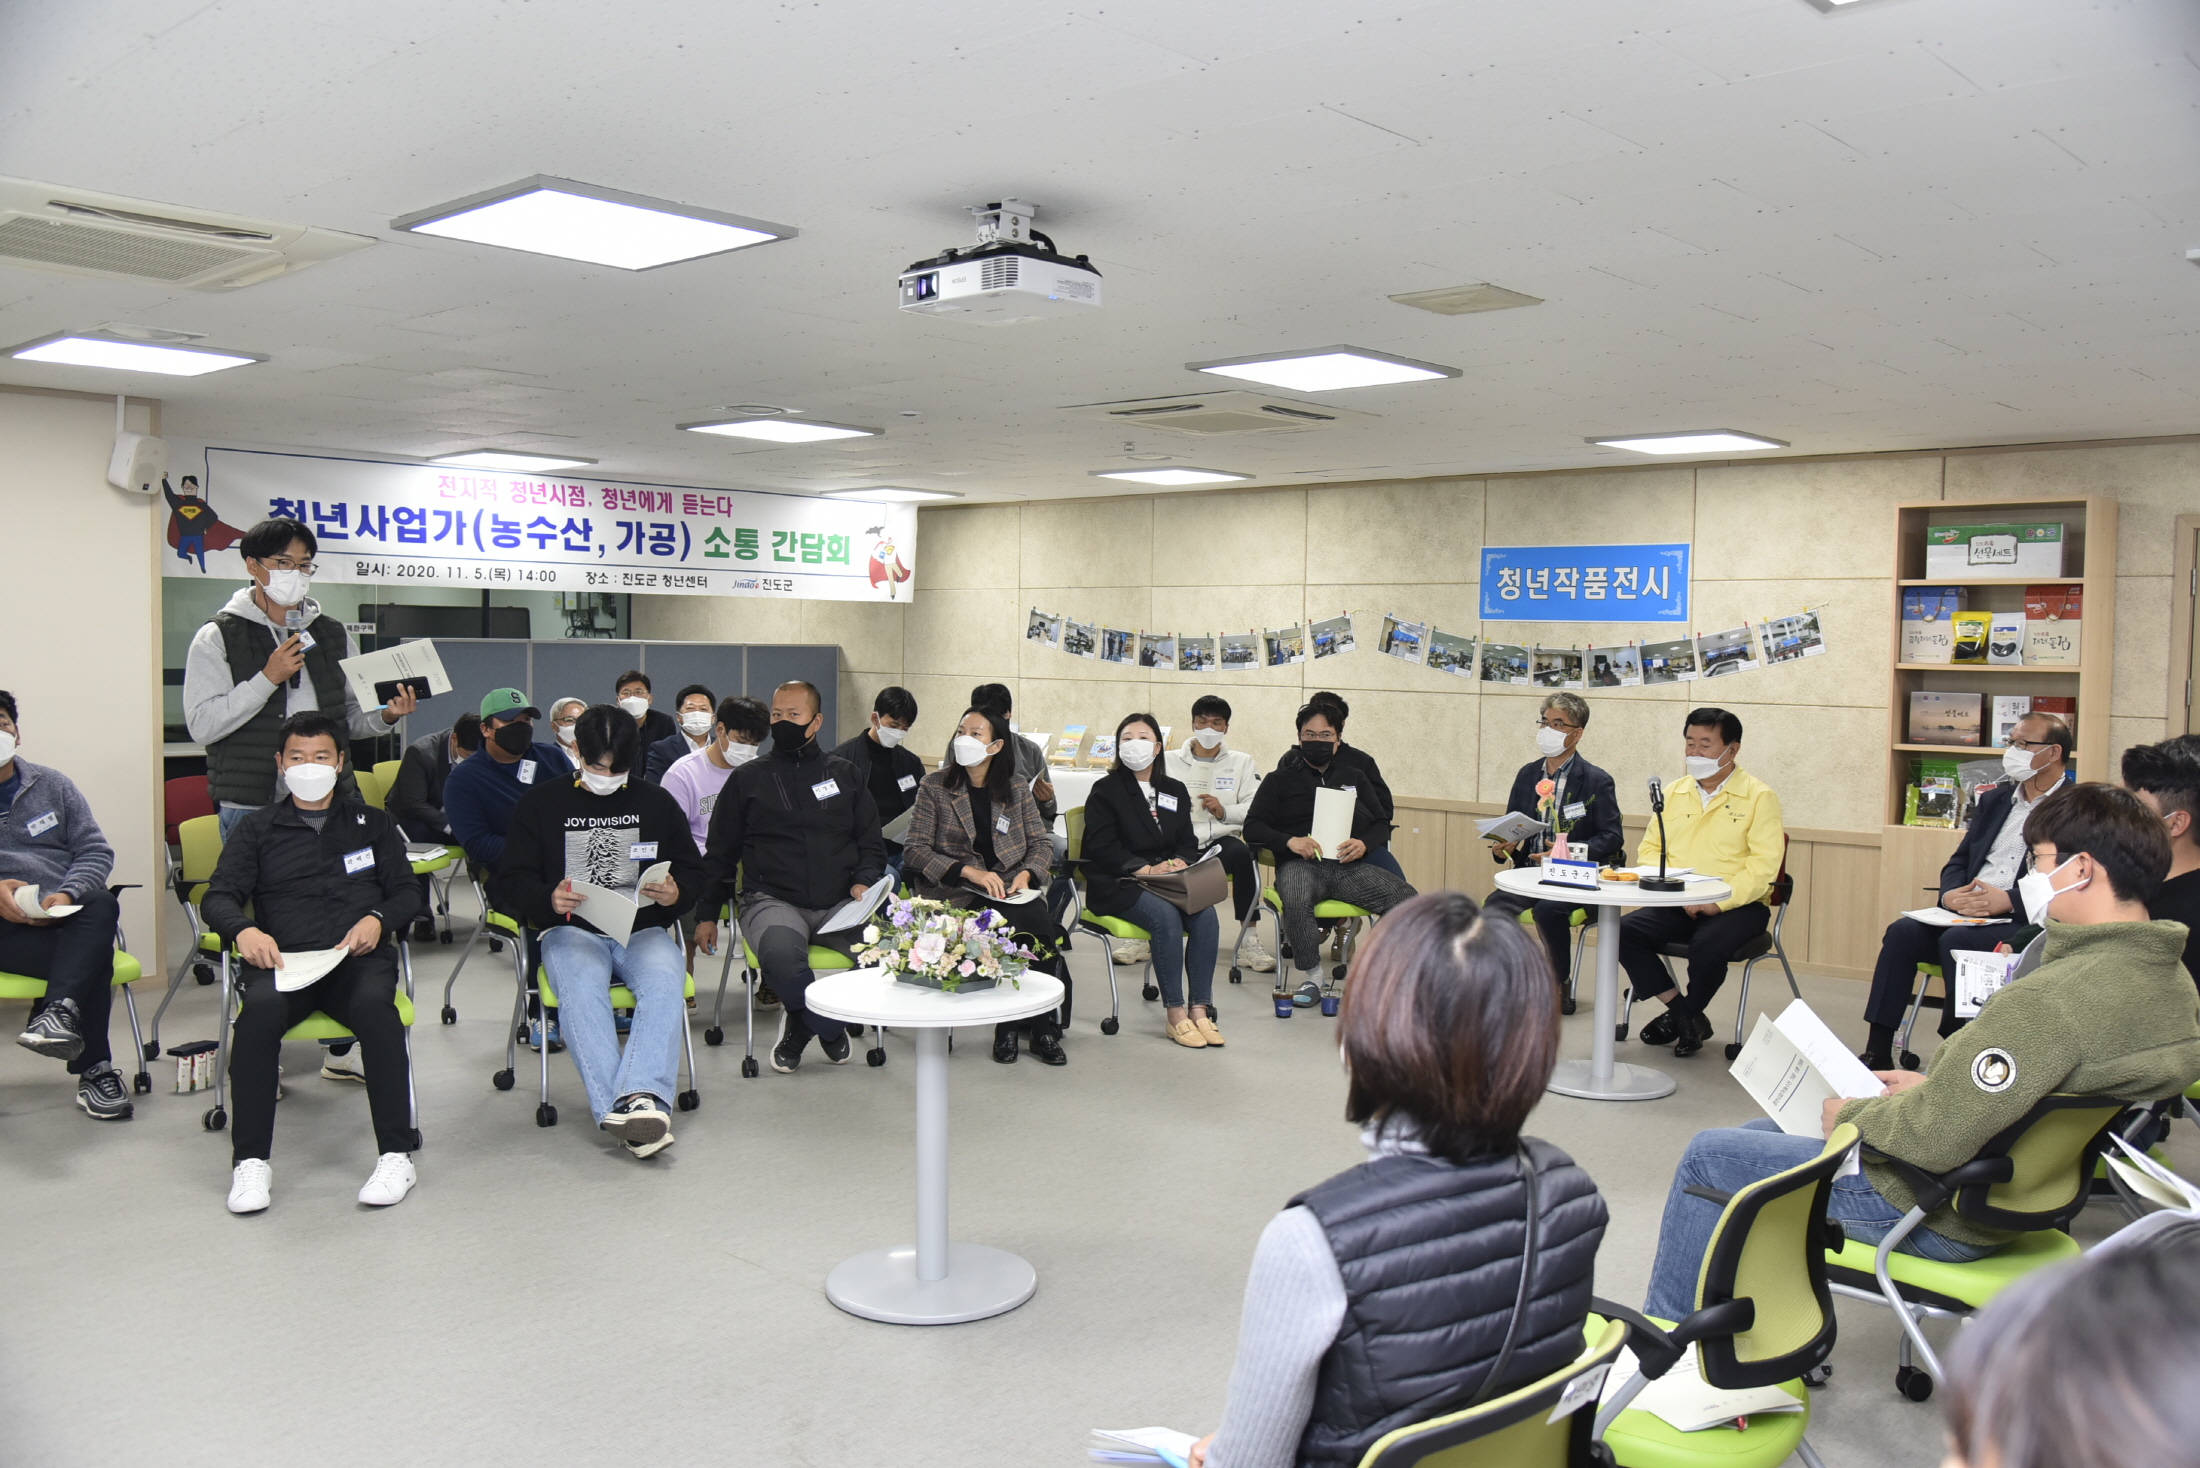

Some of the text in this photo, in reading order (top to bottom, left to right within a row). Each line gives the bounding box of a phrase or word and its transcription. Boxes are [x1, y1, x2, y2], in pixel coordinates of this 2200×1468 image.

[437, 475, 733, 518] 전지적 청년시점, 청년에게 듣는다
[704, 526, 760, 560] 소통
[771, 530, 850, 565] 간담회
[1974, 546, 2012, 559] 선물세트
[396, 564, 439, 578] 2020.
[447, 566, 468, 580] 11.
[518, 569, 557, 582] 14:00
[585, 571, 609, 585] 장소
[622, 572, 657, 587] 진도군
[662, 574, 708, 588] 청년센터
[732, 579, 756, 590] Jindo
[762, 578, 793, 591] 진도군
[1496, 566, 1669, 600] 청년작품전시
[510, 691, 522, 704] S
[699, 793, 719, 815] SU
[564, 814, 640, 827] JOY DIVISION
